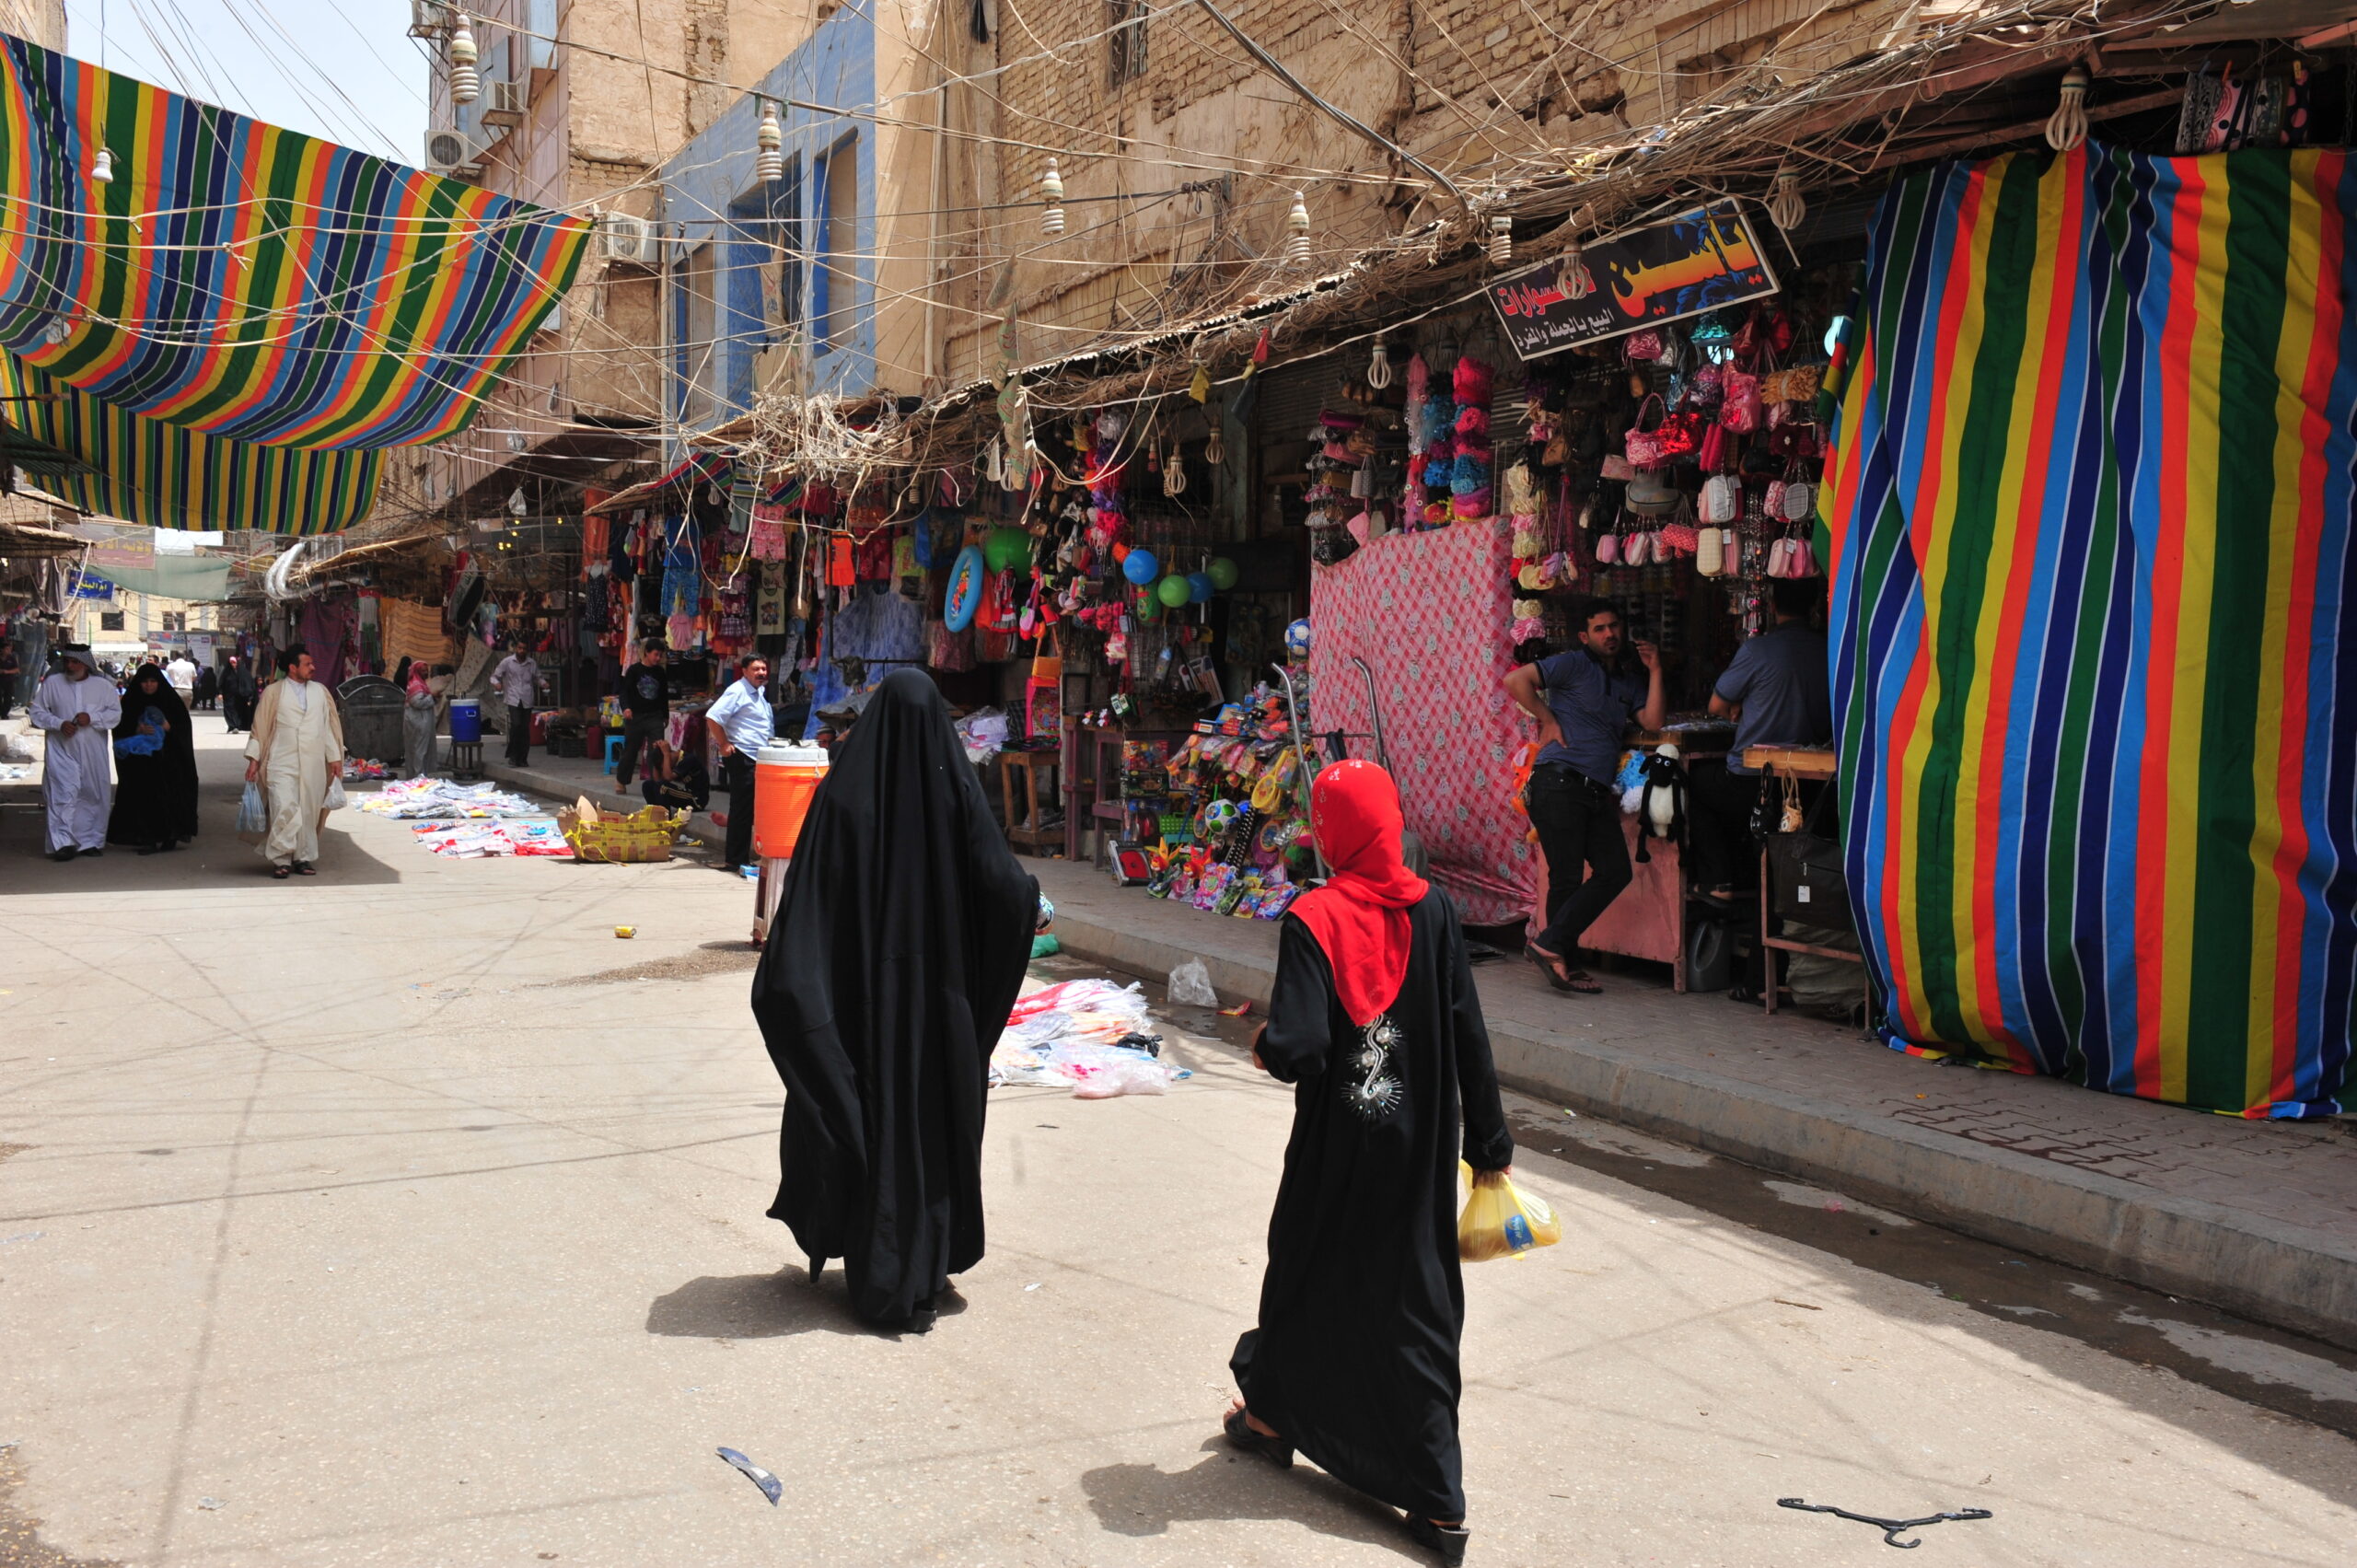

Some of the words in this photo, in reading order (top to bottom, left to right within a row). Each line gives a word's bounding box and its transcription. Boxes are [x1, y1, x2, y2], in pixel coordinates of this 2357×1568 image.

[1610, 211, 1762, 317] ياسين
[1497, 263, 1596, 318] اسوارات
[1543, 316, 1590, 340] بالجملة
[1587, 308, 1615, 335] البيع
[1516, 326, 1550, 350] والمفرد
